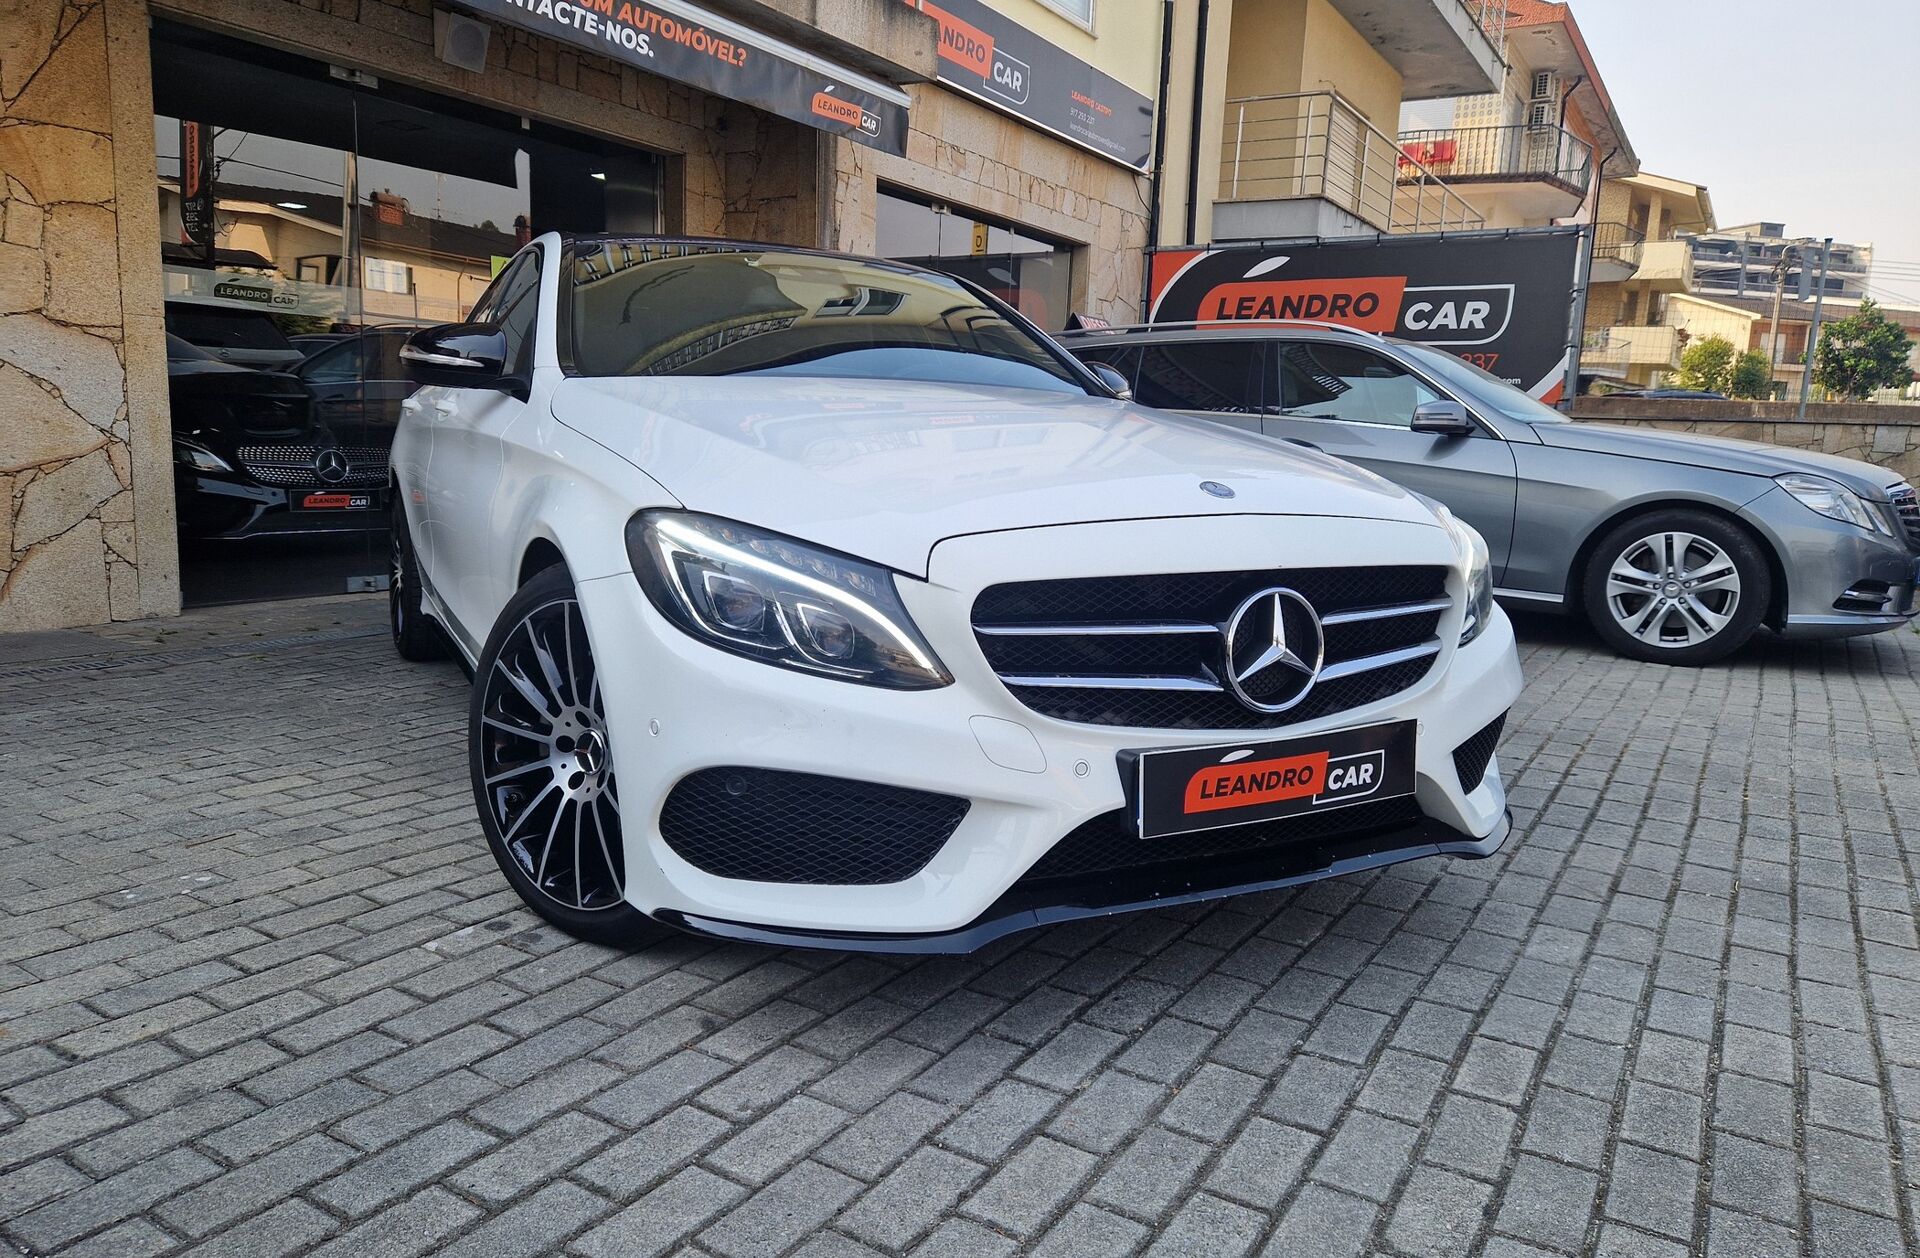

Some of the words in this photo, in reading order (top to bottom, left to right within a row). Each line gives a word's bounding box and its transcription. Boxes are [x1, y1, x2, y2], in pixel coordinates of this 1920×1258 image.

[617, 2, 747, 67] AUTOMÓVEL?
[993, 61, 1022, 92] CAR
[817, 98, 858, 120] LEANDRO
[861, 115, 877, 132] CAR
[220, 286, 268, 299] LEANDRO
[273, 296, 294, 305] CAR
[1216, 292, 1380, 321] LEANDRO
[1404, 301, 1491, 331] CAR
[308, 497, 346, 505] LEANDRO
[350, 498, 367, 506] CAR
[1200, 765, 1313, 800] LEANDRO
[1328, 763, 1374, 791] CAR
